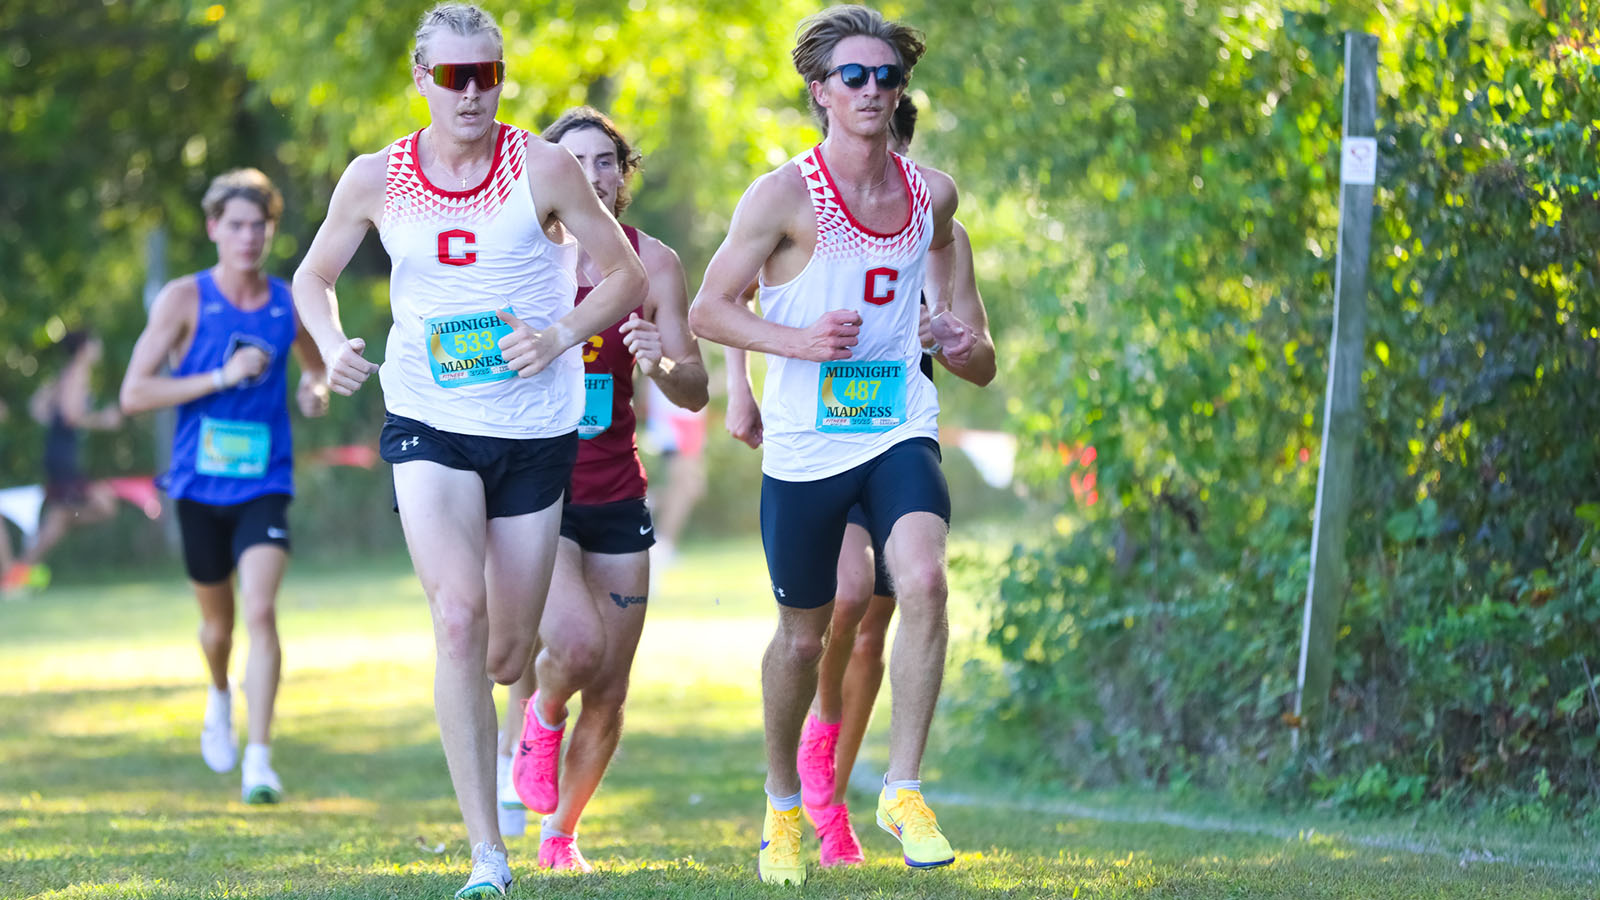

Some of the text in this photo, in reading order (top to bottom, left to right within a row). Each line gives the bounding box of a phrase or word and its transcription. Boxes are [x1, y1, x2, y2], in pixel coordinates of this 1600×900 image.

[437, 228, 477, 267] C
[864, 266, 899, 306] C
[431, 316, 508, 335] MIDNIGH
[454, 330, 495, 354] 533
[825, 366, 901, 378] MIDNIGHT
[844, 380, 881, 400] 487
[826, 406, 892, 418] MADNESS
